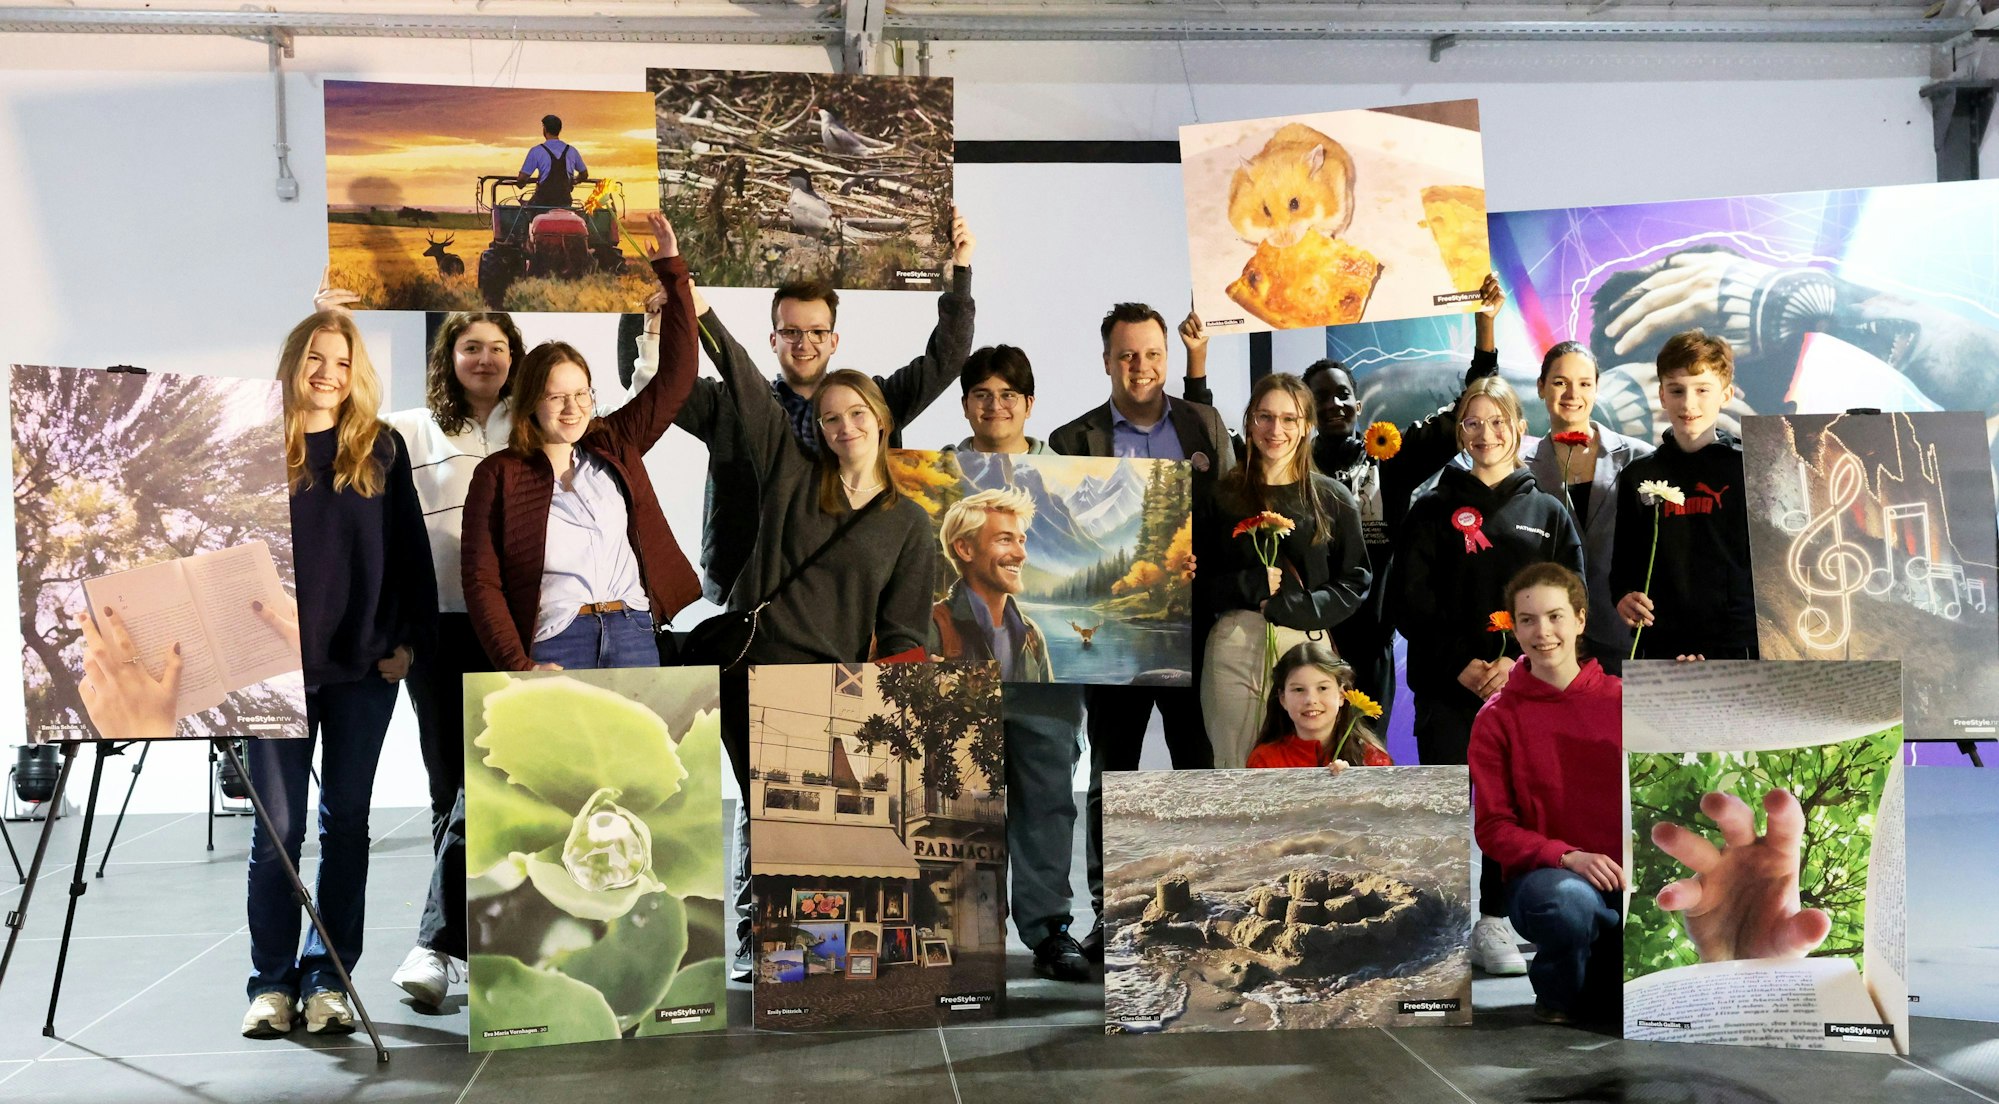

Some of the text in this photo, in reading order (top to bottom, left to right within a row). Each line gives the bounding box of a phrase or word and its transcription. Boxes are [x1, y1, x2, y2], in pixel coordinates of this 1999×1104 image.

[896, 270, 941, 279] FreeStyle.nrw
[1437, 293, 1482, 303] FreeStyle.nrw
[236, 715, 292, 723] FreeStyle.nrw
[1953, 719, 1999, 727] FreeStyle.nr
[940, 995, 992, 1004] FreeStyle.nrw
[1403, 1002, 1457, 1010] FreeStyle.nrw
[660, 1008, 712, 1018] FreeStyle.nrw
[1830, 1025, 1890, 1035] FreeStyle.nrw
